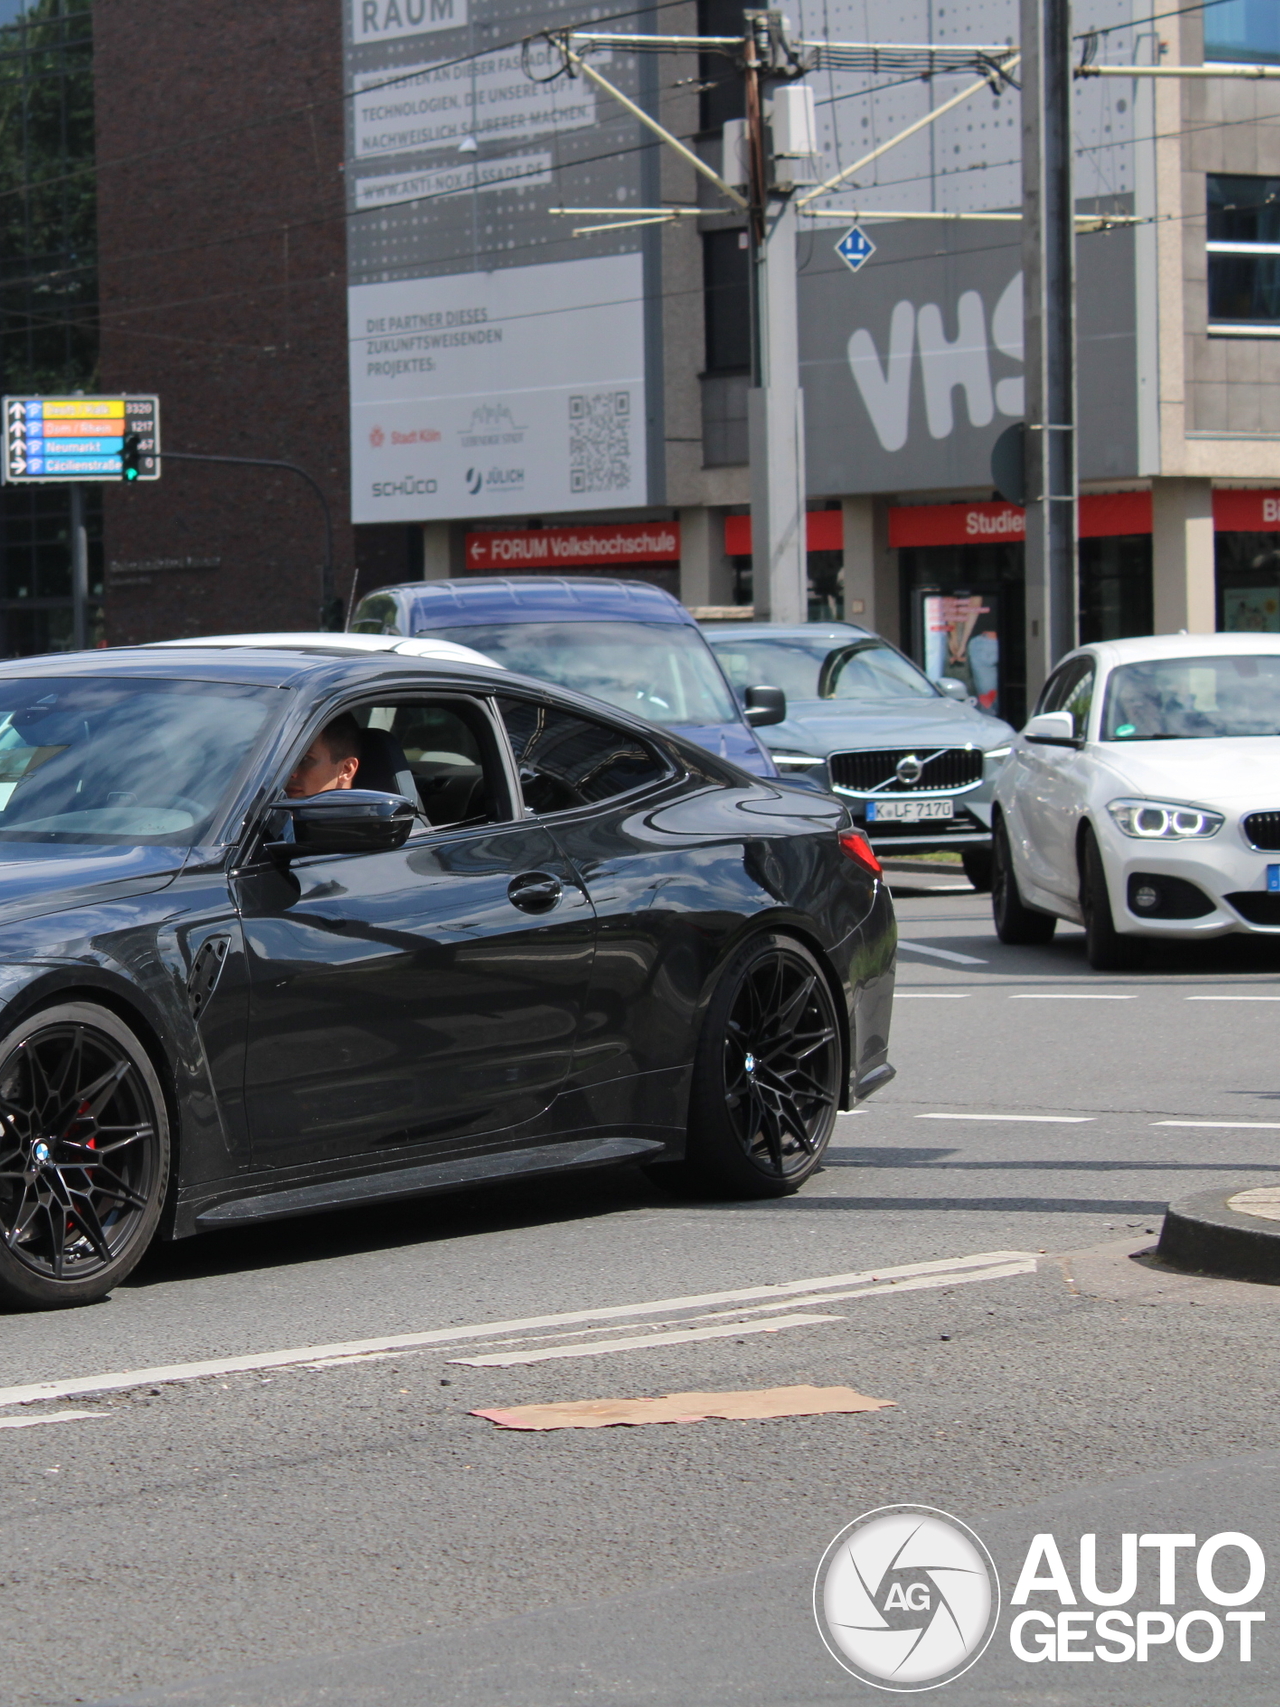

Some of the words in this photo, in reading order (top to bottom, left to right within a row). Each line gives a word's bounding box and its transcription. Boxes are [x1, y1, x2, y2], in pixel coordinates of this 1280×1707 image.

[362, 0, 454, 33] RAUM
[387, 70, 430, 89] TESTEN
[433, 67, 451, 82] AN
[453, 60, 495, 79] DIESER
[362, 95, 462, 121] TECHNOLOGIEN,
[487, 82, 538, 103] UNSERE
[543, 77, 573, 94] LUFT
[362, 121, 457, 151] NACHWEISLICH
[529, 106, 590, 125] MACHEN.
[367, 319, 387, 333] DIE
[389, 312, 443, 331] PARTNER
[445, 308, 488, 326] DIESES
[367, 329, 502, 355] ZUKUNFTSWEISENDEN
[367, 357, 437, 378] PROJEKTES:
[126, 403, 152, 414] 3320
[46, 423, 71, 435] Dom
[132, 421, 154, 432] 1217
[46, 441, 101, 453] Neumarkt
[46, 458, 123, 472] Cäcilienstraße
[486, 466, 524, 485] JÜLICH
[372, 475, 438, 497] SCHÜCO
[491, 538, 548, 561] FORUM
[551, 531, 676, 557] Volkshochschule
[916, 801, 951, 816] 7170
